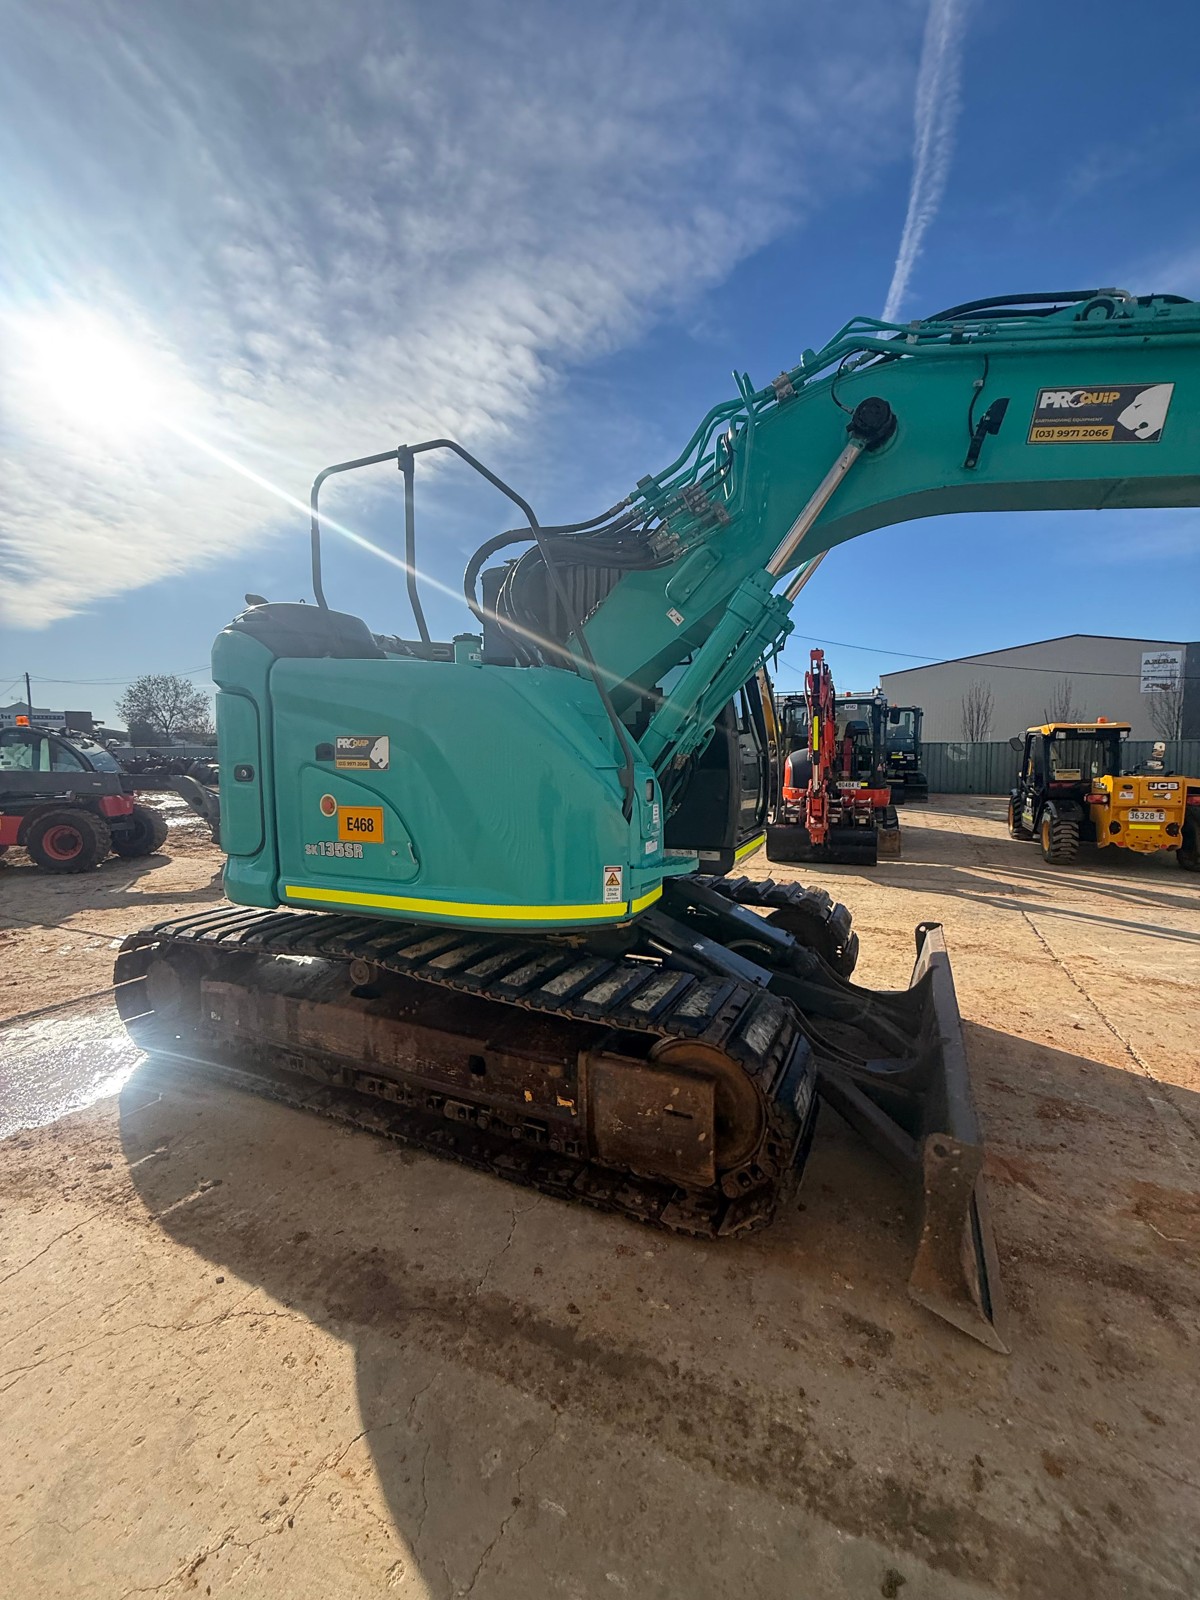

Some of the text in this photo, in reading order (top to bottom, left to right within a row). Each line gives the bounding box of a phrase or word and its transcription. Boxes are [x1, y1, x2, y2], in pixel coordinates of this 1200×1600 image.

[1035, 429, 1109, 438] (03) 9971 2066
[1148, 782, 1178, 790] JCB
[1130, 812, 1164, 820] 36328 E
[346, 817, 374, 832] E468
